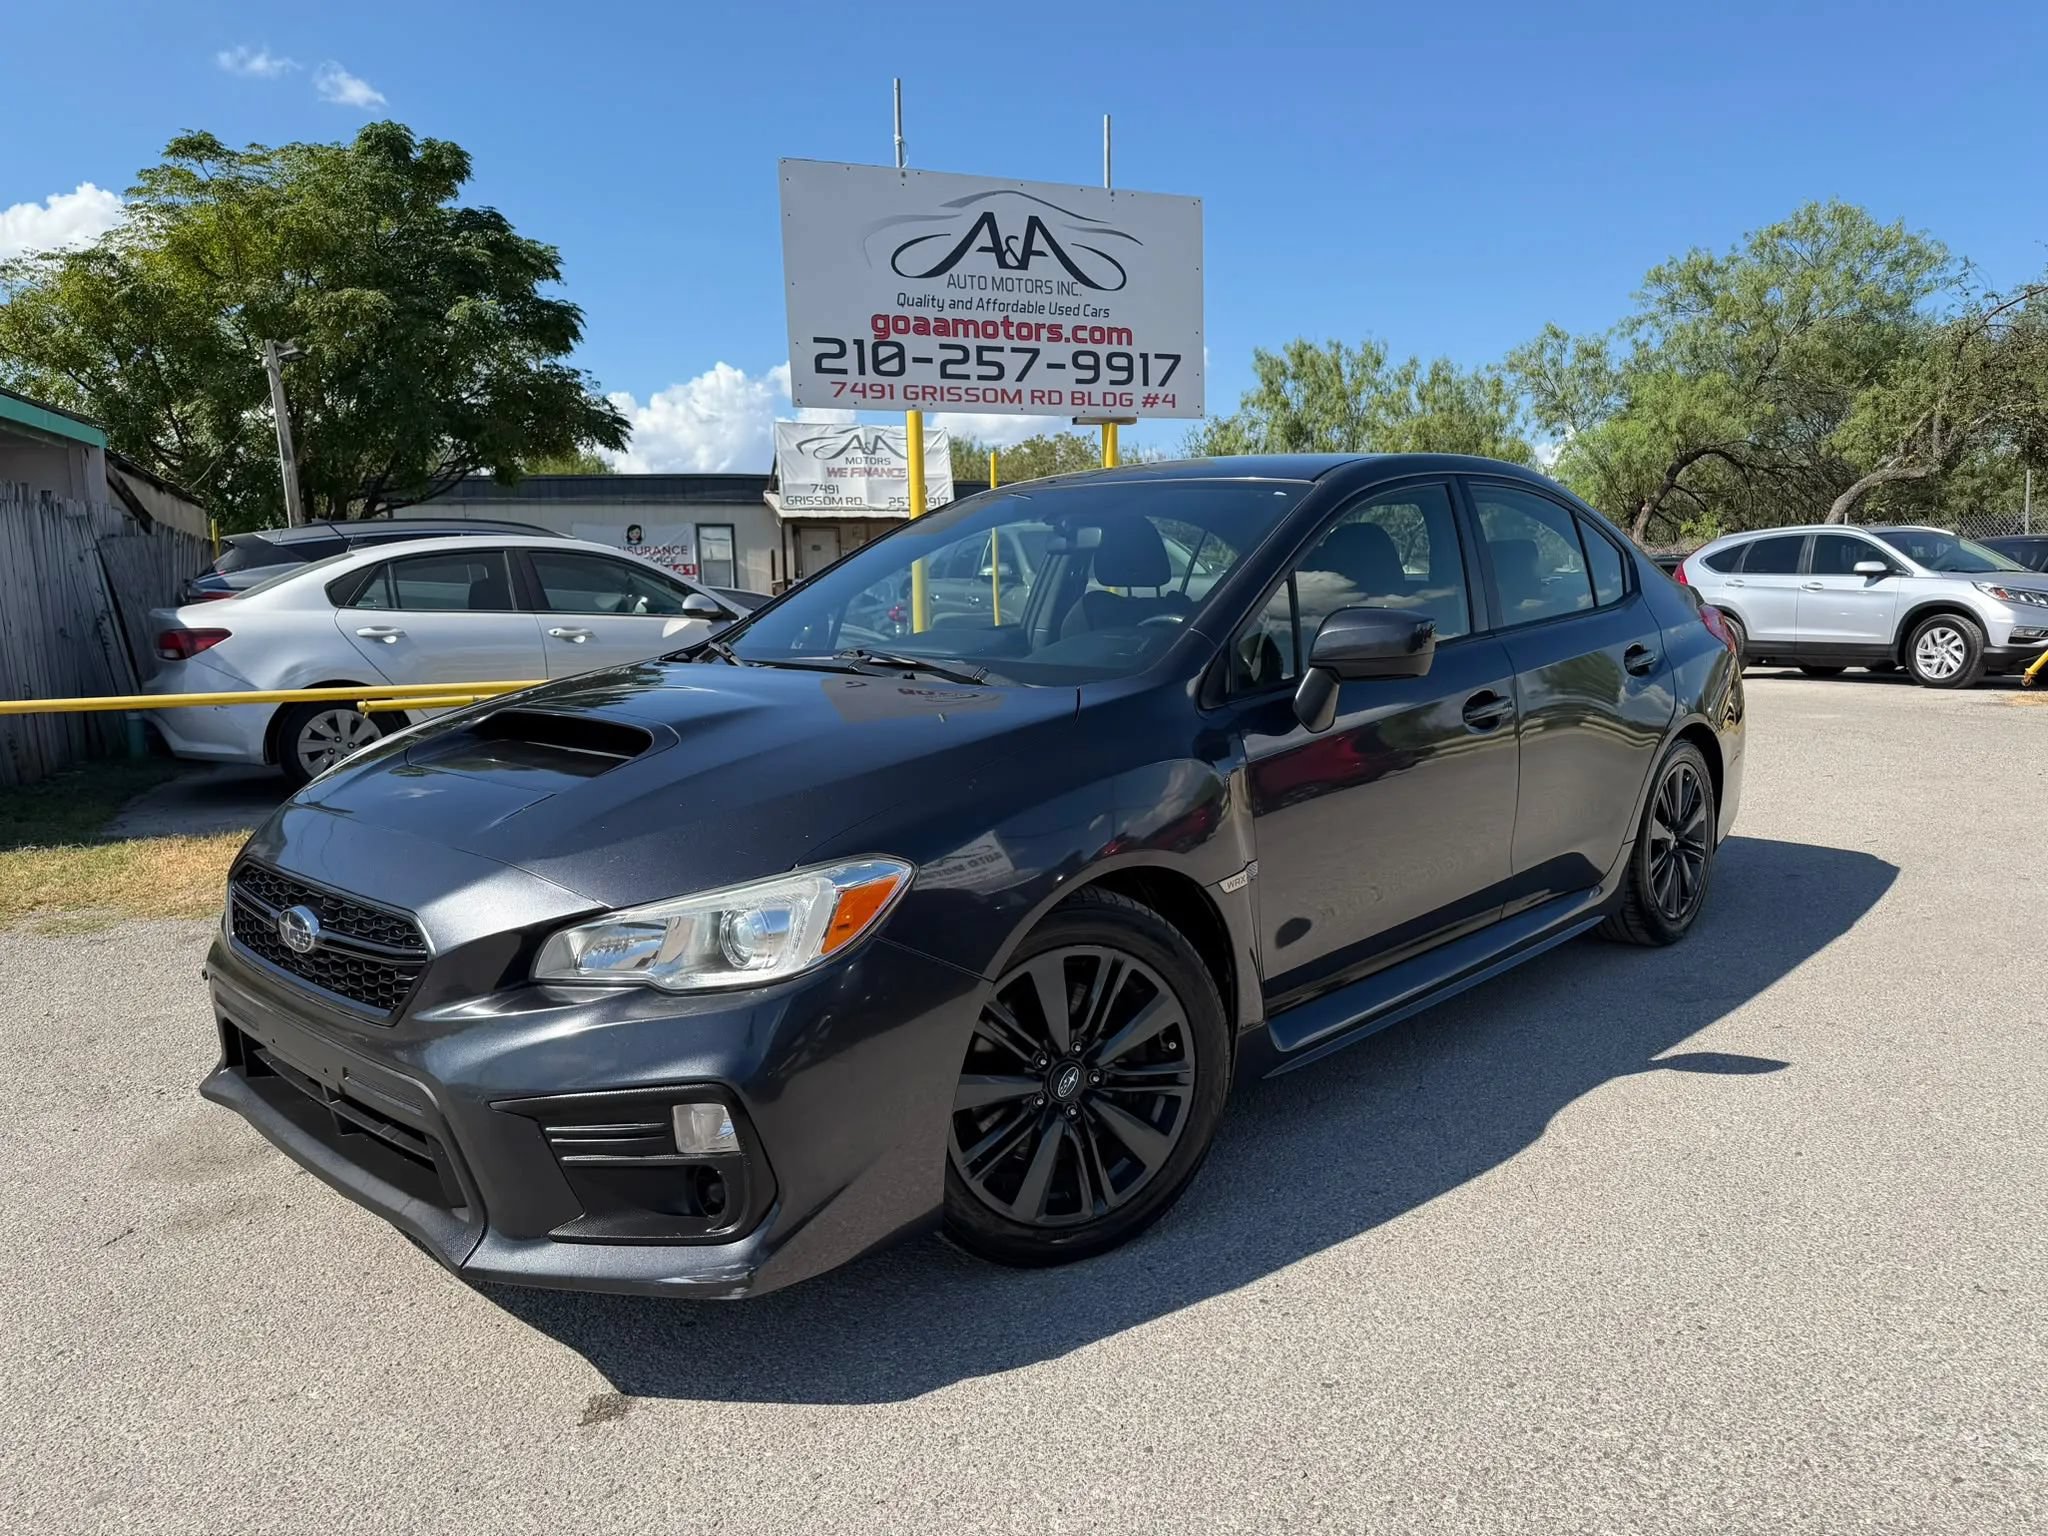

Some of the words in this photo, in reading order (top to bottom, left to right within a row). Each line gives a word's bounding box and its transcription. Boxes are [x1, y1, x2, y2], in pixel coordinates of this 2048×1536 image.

[946, 273, 988, 291] AUTO
[991, 277, 1054, 295] MOTORS
[1056, 281, 1083, 297] INC.
[896, 292, 945, 312] Quality
[948, 295, 973, 310] and
[975, 297, 1046, 315] Affordable
[1048, 301, 1081, 317] Used
[1083, 304, 1111, 318] Cars
[870, 313, 1133, 346] goaamotors.com
[812, 336, 1182, 388] 210-257-9917
[830, 381, 895, 400] 7491
[902, 384, 1024, 406] GRISSOM
[1030, 389, 1063, 406] RD
[1070, 390, 1134, 408] BLDG
[1141, 392, 1177, 409] #4
[845, 456, 891, 466] MOTORS
[826, 467, 848, 478] WE
[850, 467, 907, 478] FINANCE
[810, 483, 840, 495] 7491
[785, 495, 843, 506] GRISSOM
[1227, 874, 1246, 889] WRX
